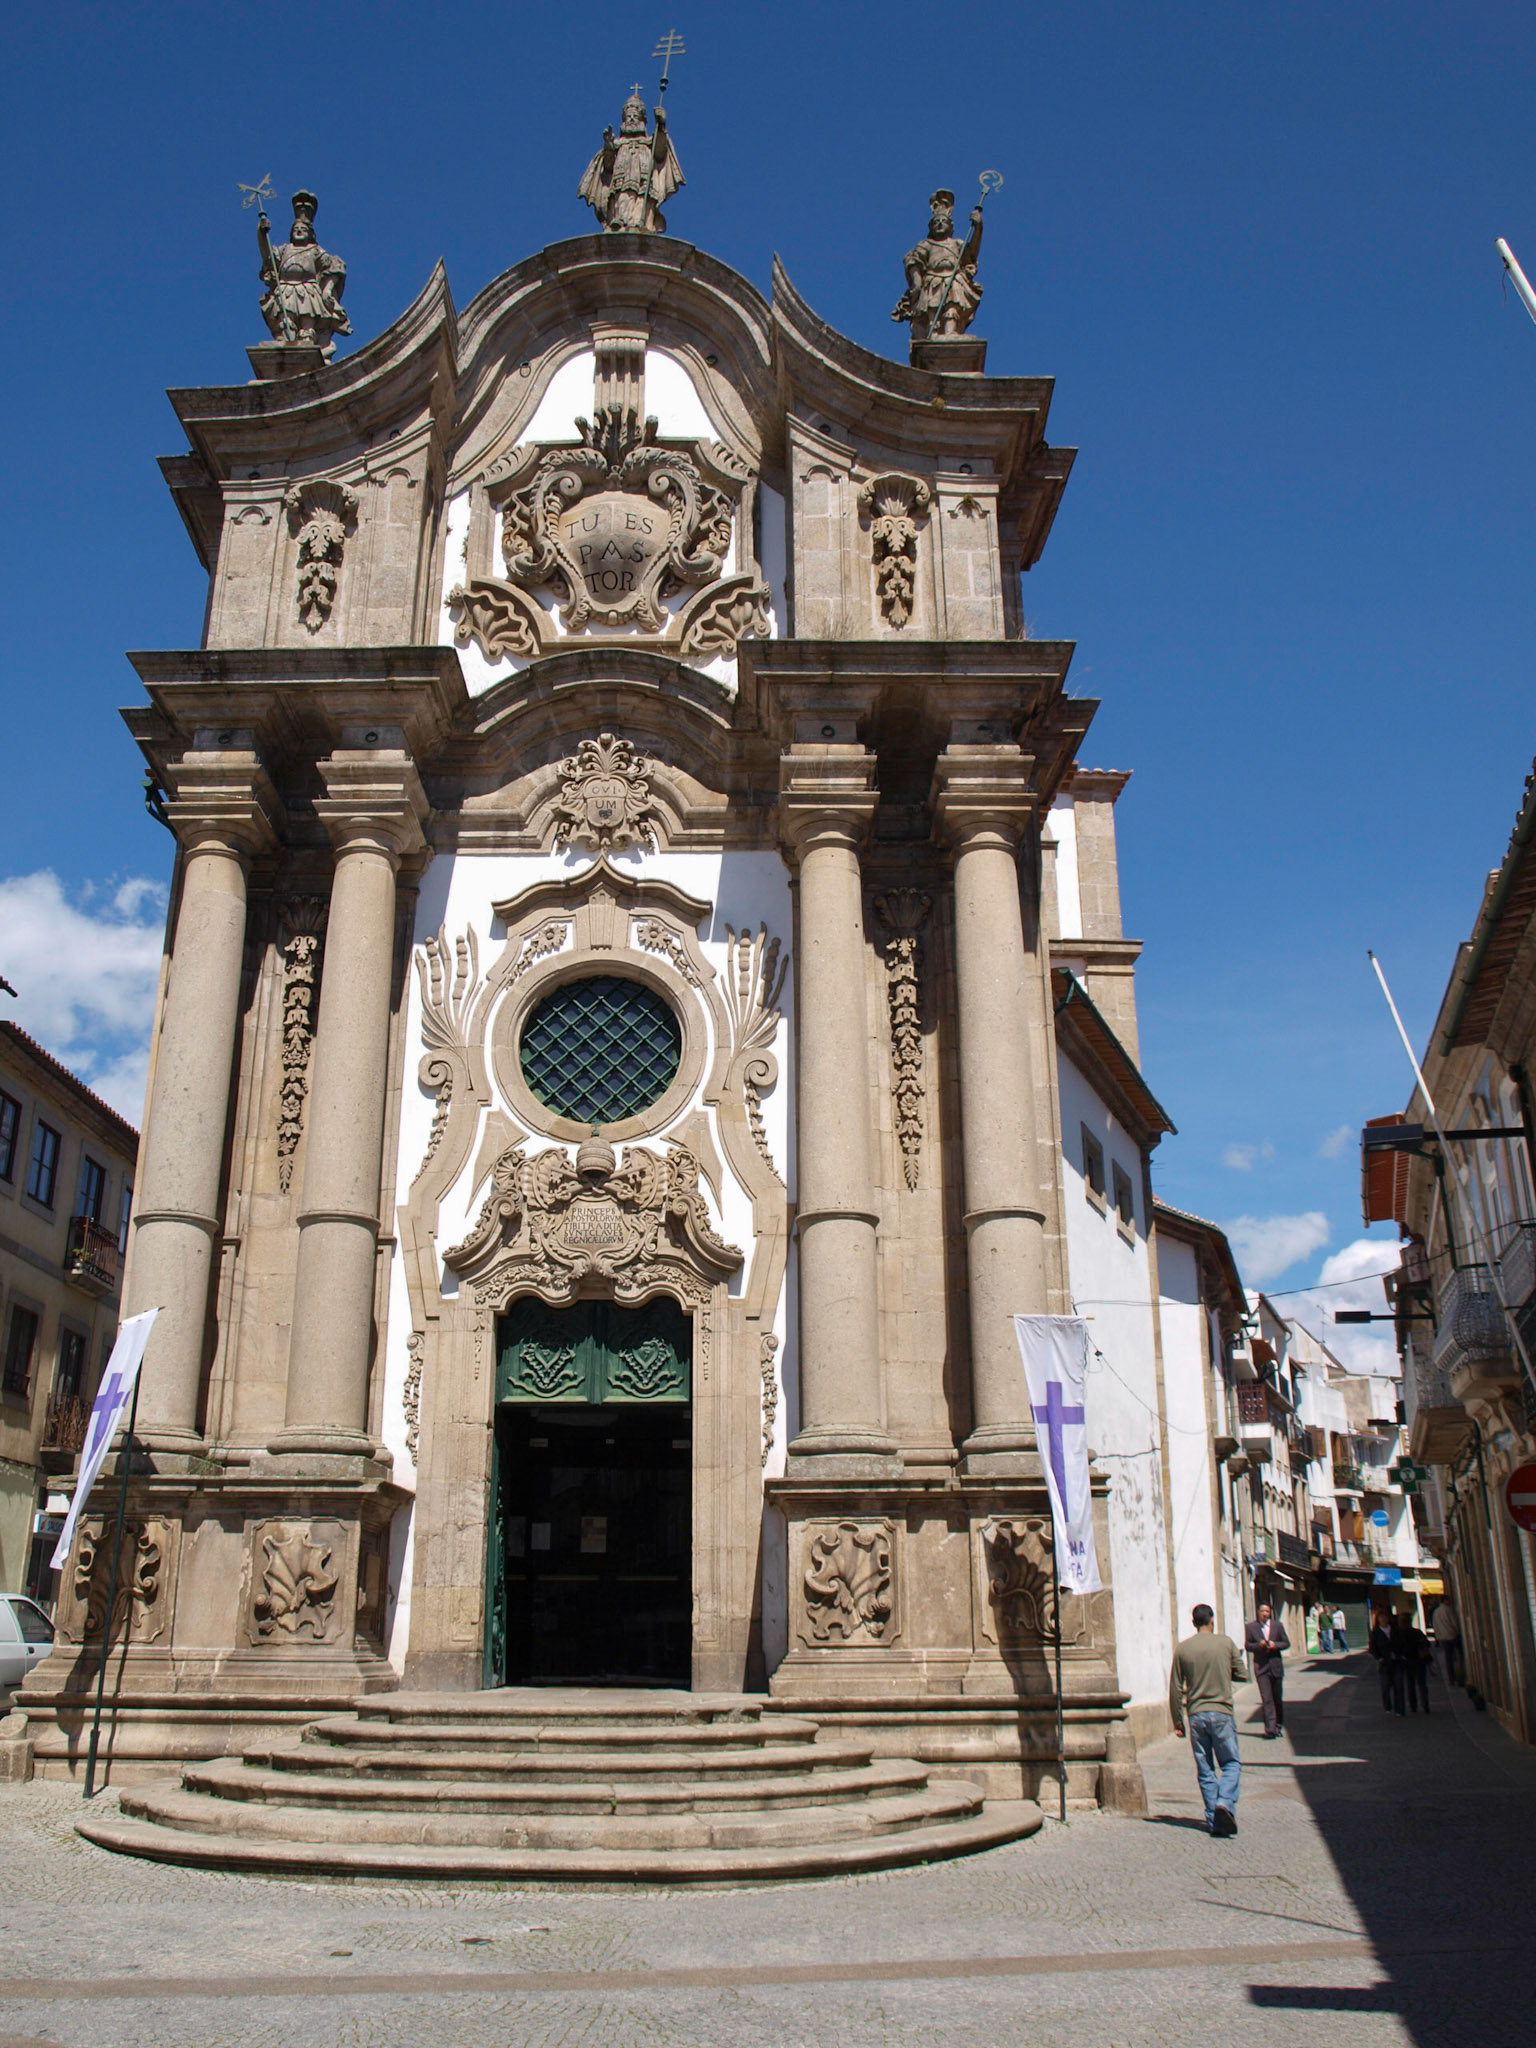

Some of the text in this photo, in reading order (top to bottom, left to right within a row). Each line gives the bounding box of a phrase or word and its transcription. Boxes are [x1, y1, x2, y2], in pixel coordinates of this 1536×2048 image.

[565, 512, 654, 538] TU ES
[584, 570, 637, 593] TOR
[595, 800, 616, 809] UM
[571, 1207, 616, 1215] PRINCEPS
